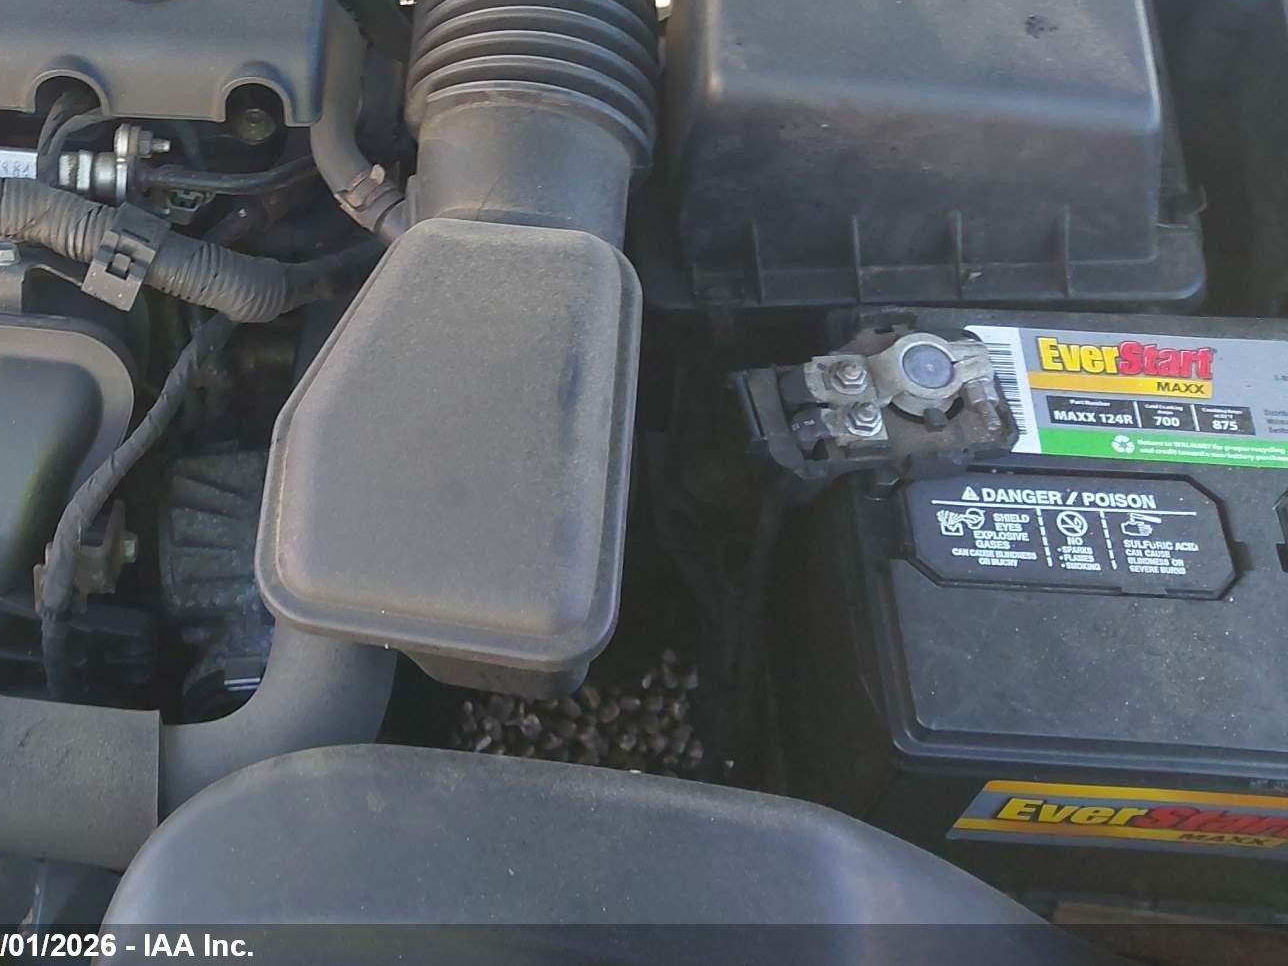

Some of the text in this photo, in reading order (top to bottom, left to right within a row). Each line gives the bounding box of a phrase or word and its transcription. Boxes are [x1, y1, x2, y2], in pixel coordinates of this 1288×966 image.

[1036, 336, 1215, 380] EverStart
[1156, 380, 1206, 395] MAXX
[1053, 410, 1134, 424] MAXX 124R
[1153, 416, 1180, 427] 700
[1212, 420, 1238, 431] 875
[981, 488, 1157, 509] DANGER / POISON
[993, 513, 1030, 523] SHIELD
[995, 523, 1023, 532] EYES
[973, 530, 1030, 541] EXPLOSIVE
[1066, 536, 1083, 545] NO
[976, 540, 1010, 549] GASES
[1123, 539, 1173, 550] SULFURIC
[1129, 565, 1159, 574] SEVERE
[1177, 833, 1265, 847] MAXX
